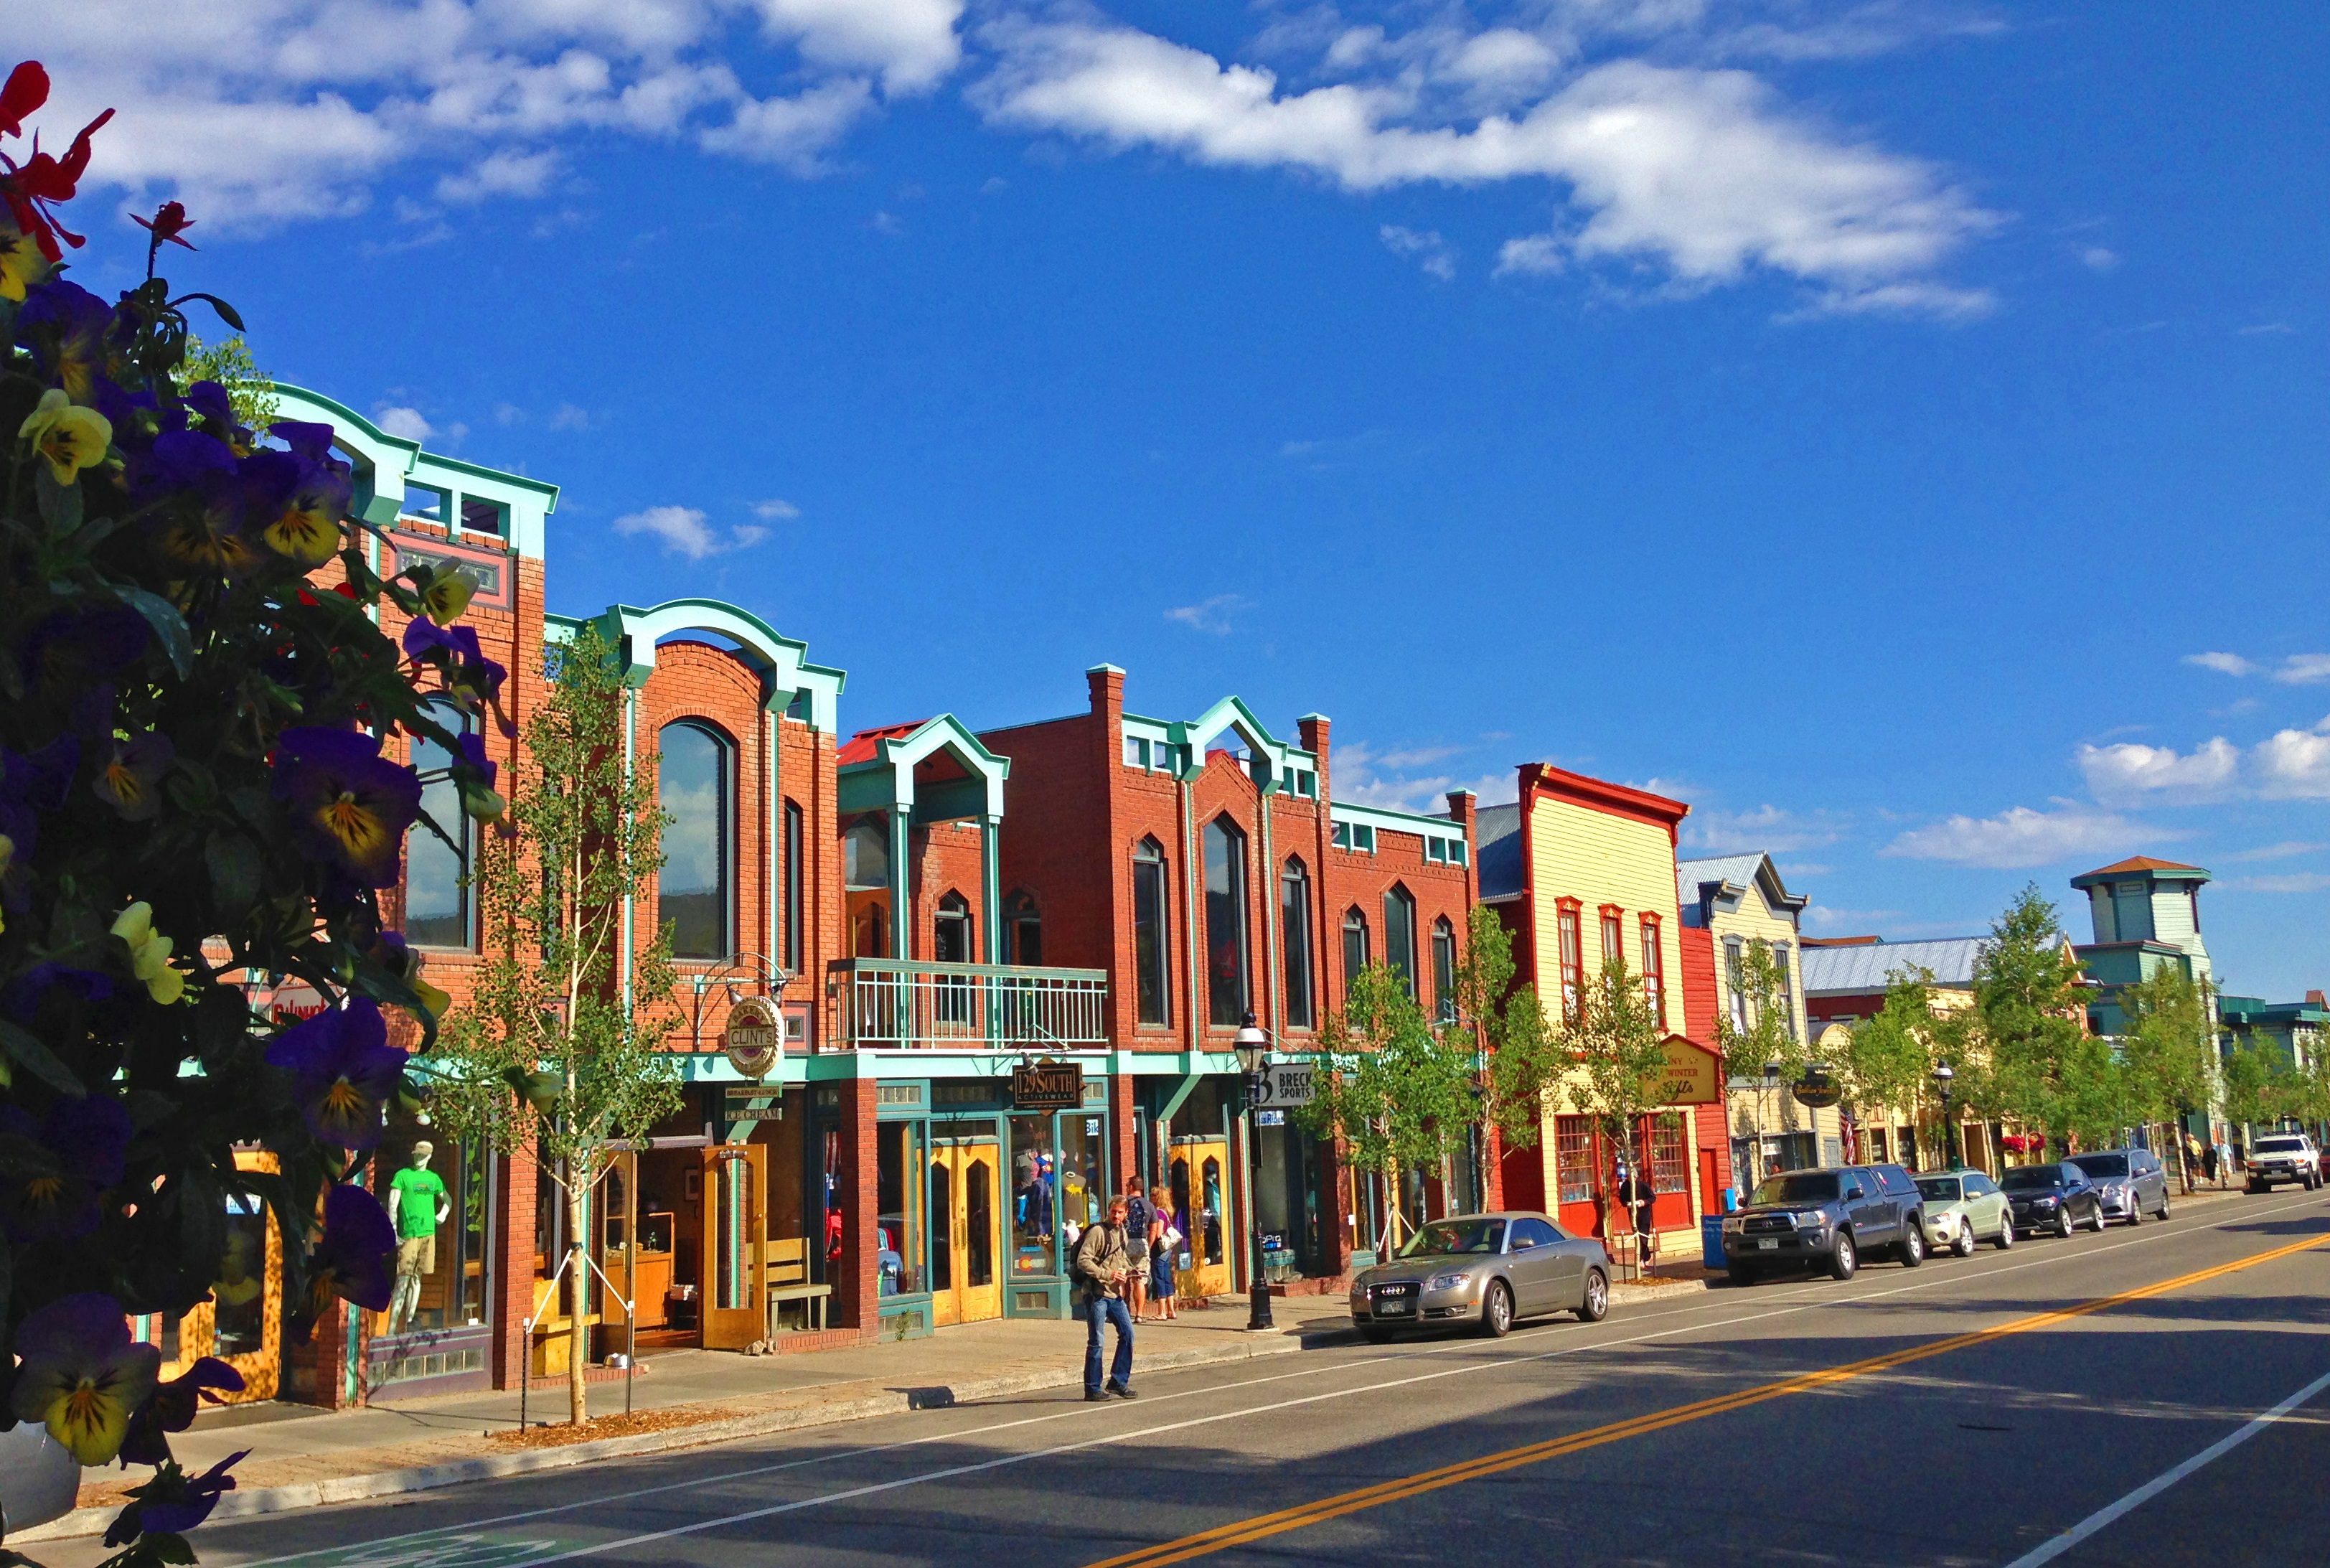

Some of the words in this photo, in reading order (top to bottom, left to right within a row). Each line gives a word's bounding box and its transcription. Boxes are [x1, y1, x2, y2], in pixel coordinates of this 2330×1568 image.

[1018, 1073, 1035, 1093] 129
[1036, 1071, 1073, 1093] SOUTH
[1279, 1073, 1312, 1087] BRECK
[1279, 1087, 1310, 1098] SPORTS
[727, 1110, 742, 1119] ICE
[744, 1109, 779, 1119] CREAM
